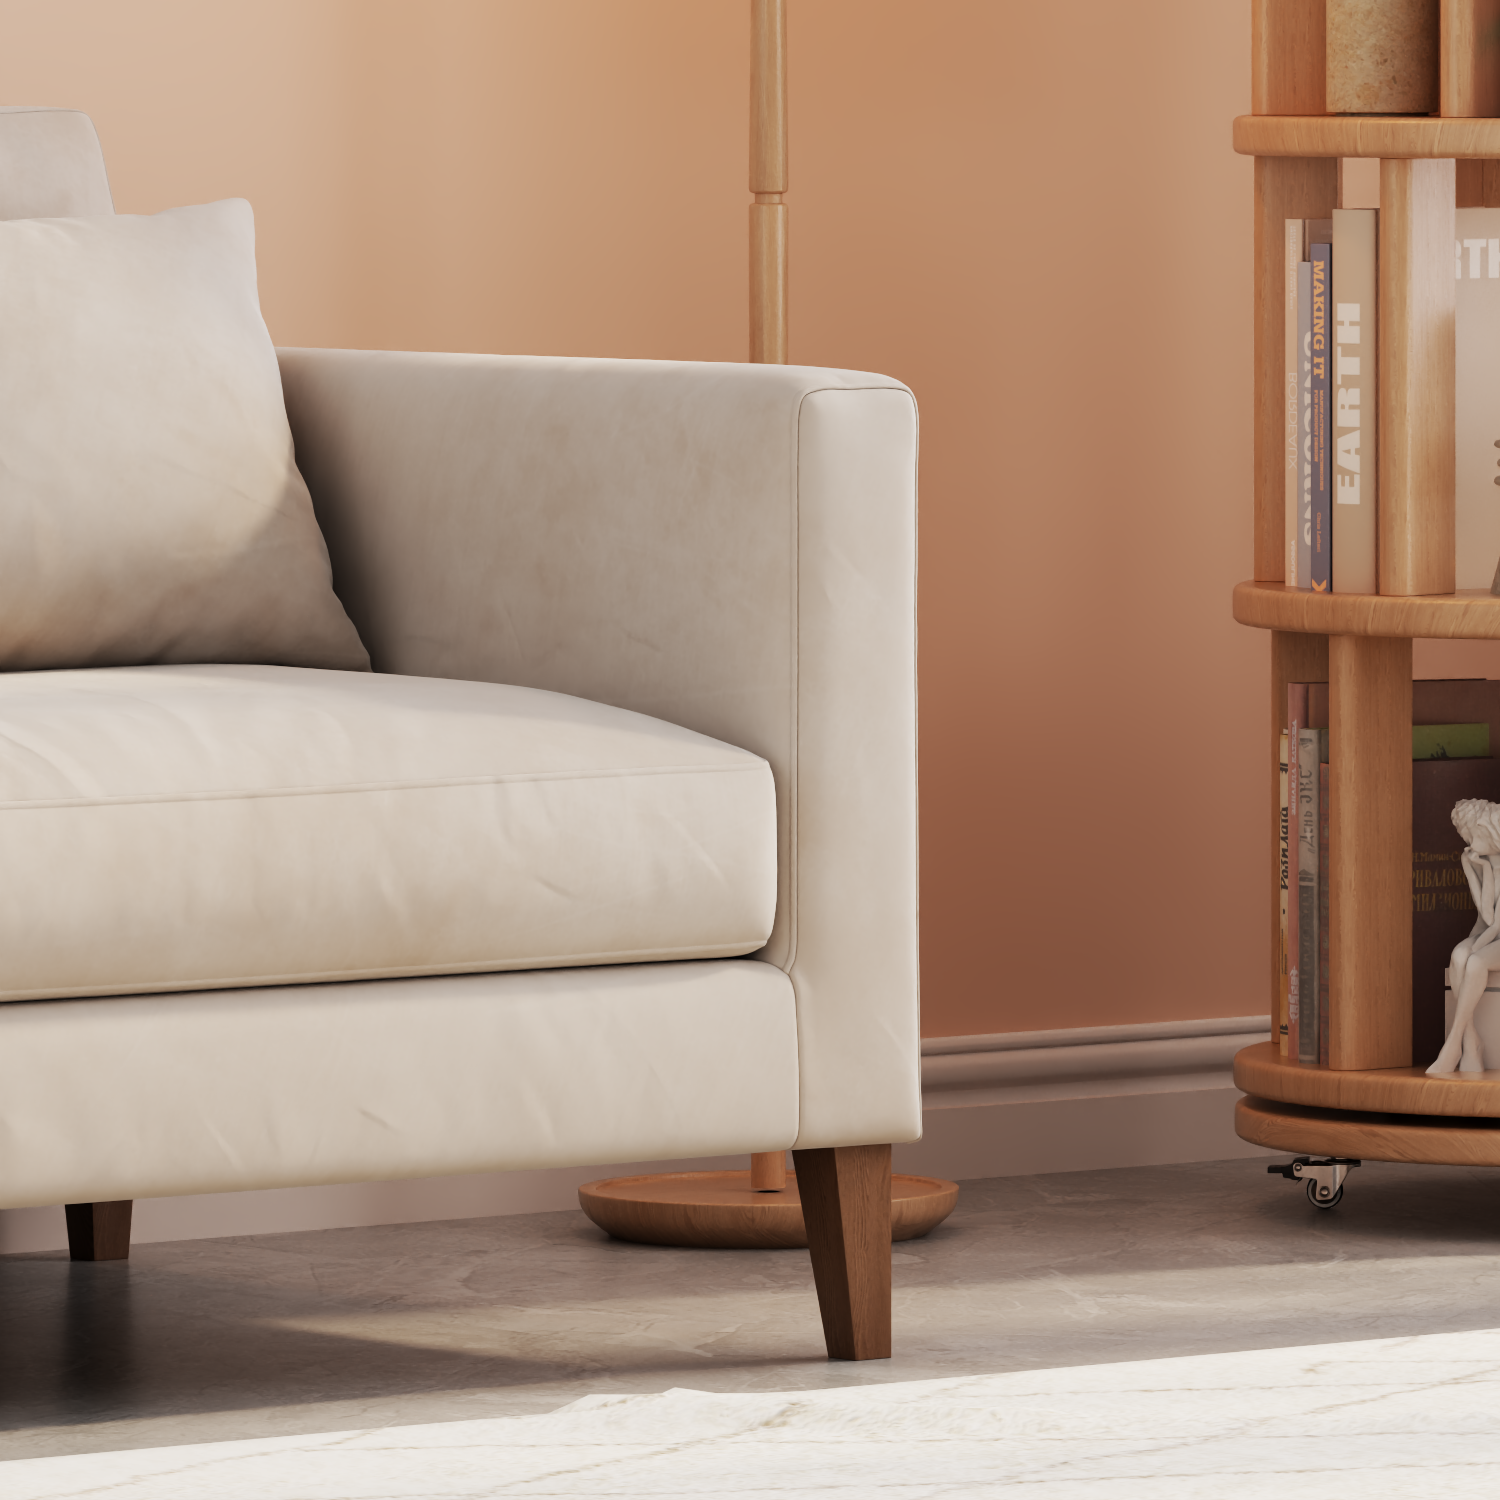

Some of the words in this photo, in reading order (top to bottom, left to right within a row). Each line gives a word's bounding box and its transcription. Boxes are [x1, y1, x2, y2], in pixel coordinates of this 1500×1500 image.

[1313, 260, 1325, 350] MAKING
[1313, 356, 1325, 380] IT
[1336, 303, 1361, 505] EARTH
